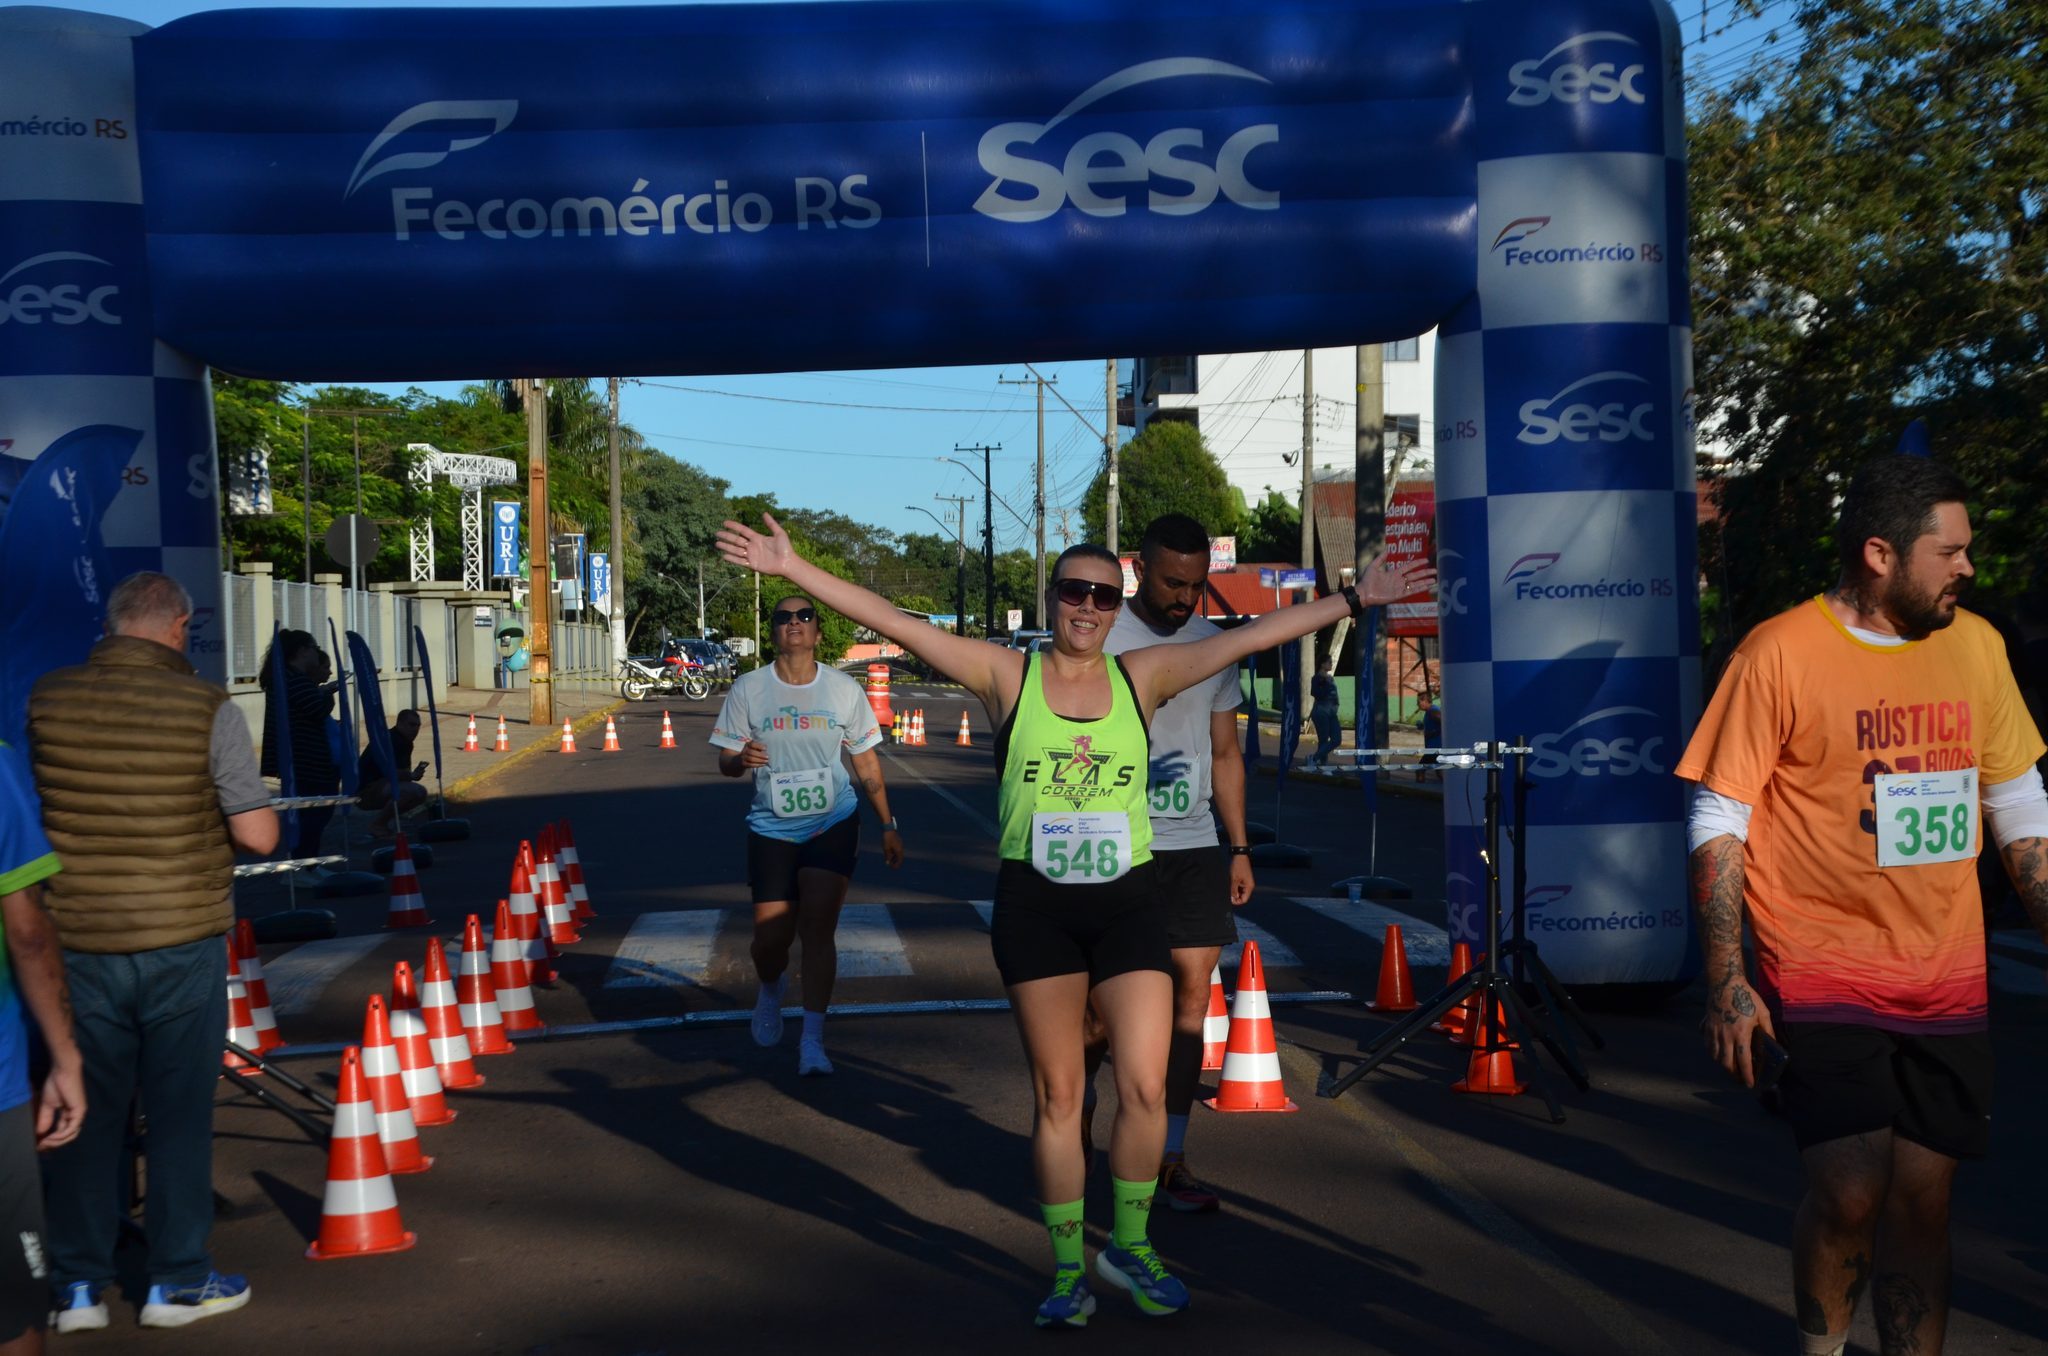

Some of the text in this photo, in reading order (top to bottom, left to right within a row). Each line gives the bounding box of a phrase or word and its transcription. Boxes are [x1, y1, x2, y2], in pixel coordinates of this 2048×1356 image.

[1506, 58, 1645, 107] Sesc
[96, 118, 128, 139] RS
[972, 121, 1281, 223] Sesc
[391, 173, 883, 241] Fecomércio RS
[1505, 242, 1664, 266] Fecomércio RS
[1456, 419, 1477, 440] RS
[1516, 398, 1655, 445] Sesc
[500, 526, 514, 574] URI
[1517, 578, 1673, 600] Fecomércio RS
[762, 715, 837, 731] Autismo
[1856, 699, 1972, 752] RÚSTICA
[1527, 732, 1665, 778] Sesc
[780, 785, 828, 814] 363
[1041, 785, 1114, 798] CORREM
[1148, 780, 1190, 812] 56
[1887, 786, 1918, 797] Sesc
[1042, 823, 1074, 835] Sesc
[1894, 803, 1969, 856] 358
[1046, 839, 1119, 879] 548
[1528, 908, 1684, 931] Fecomércio RS
